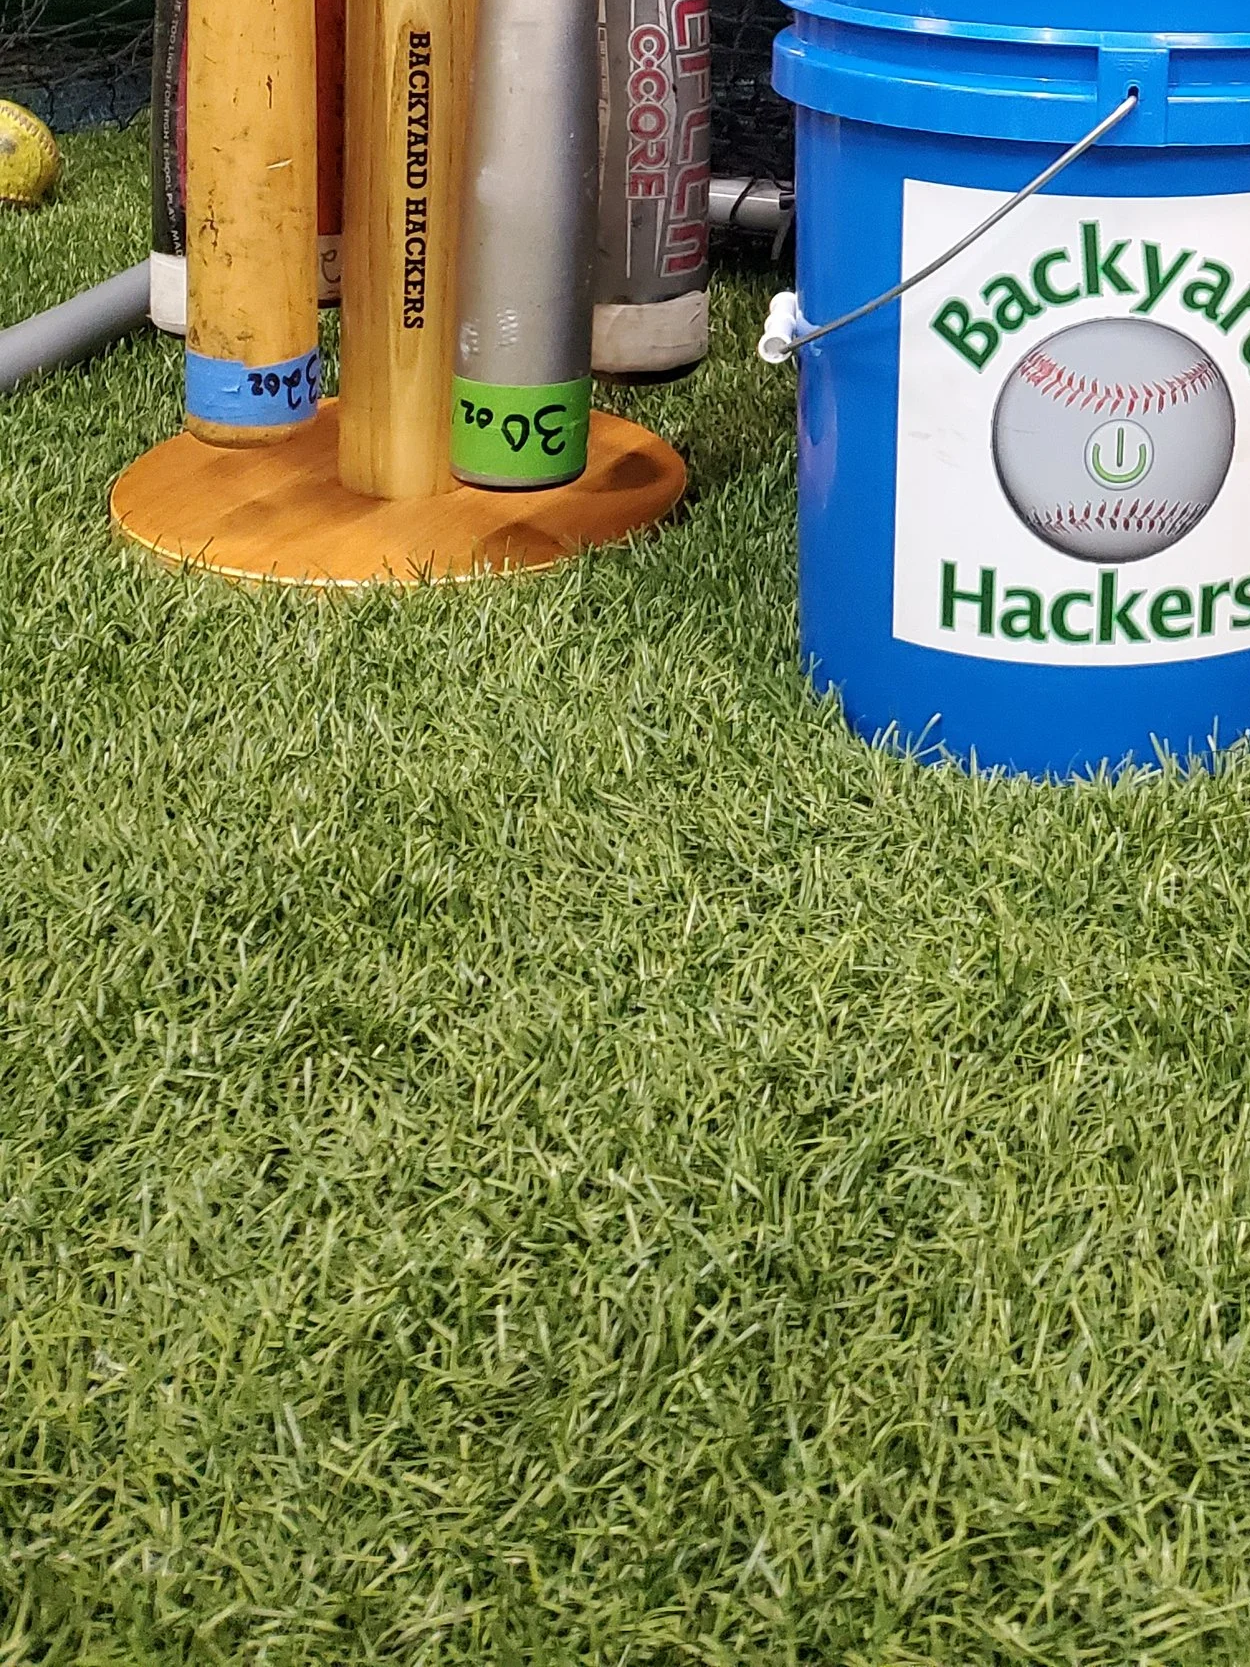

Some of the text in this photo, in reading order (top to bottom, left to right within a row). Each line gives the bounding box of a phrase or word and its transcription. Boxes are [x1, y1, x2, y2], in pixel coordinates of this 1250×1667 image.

[169, 19, 180, 44] TOO
[402, 31, 432, 330] BACKYARD HACKERS
[166, 193, 177, 222] PLAY
[501, 404, 567, 456] 30
